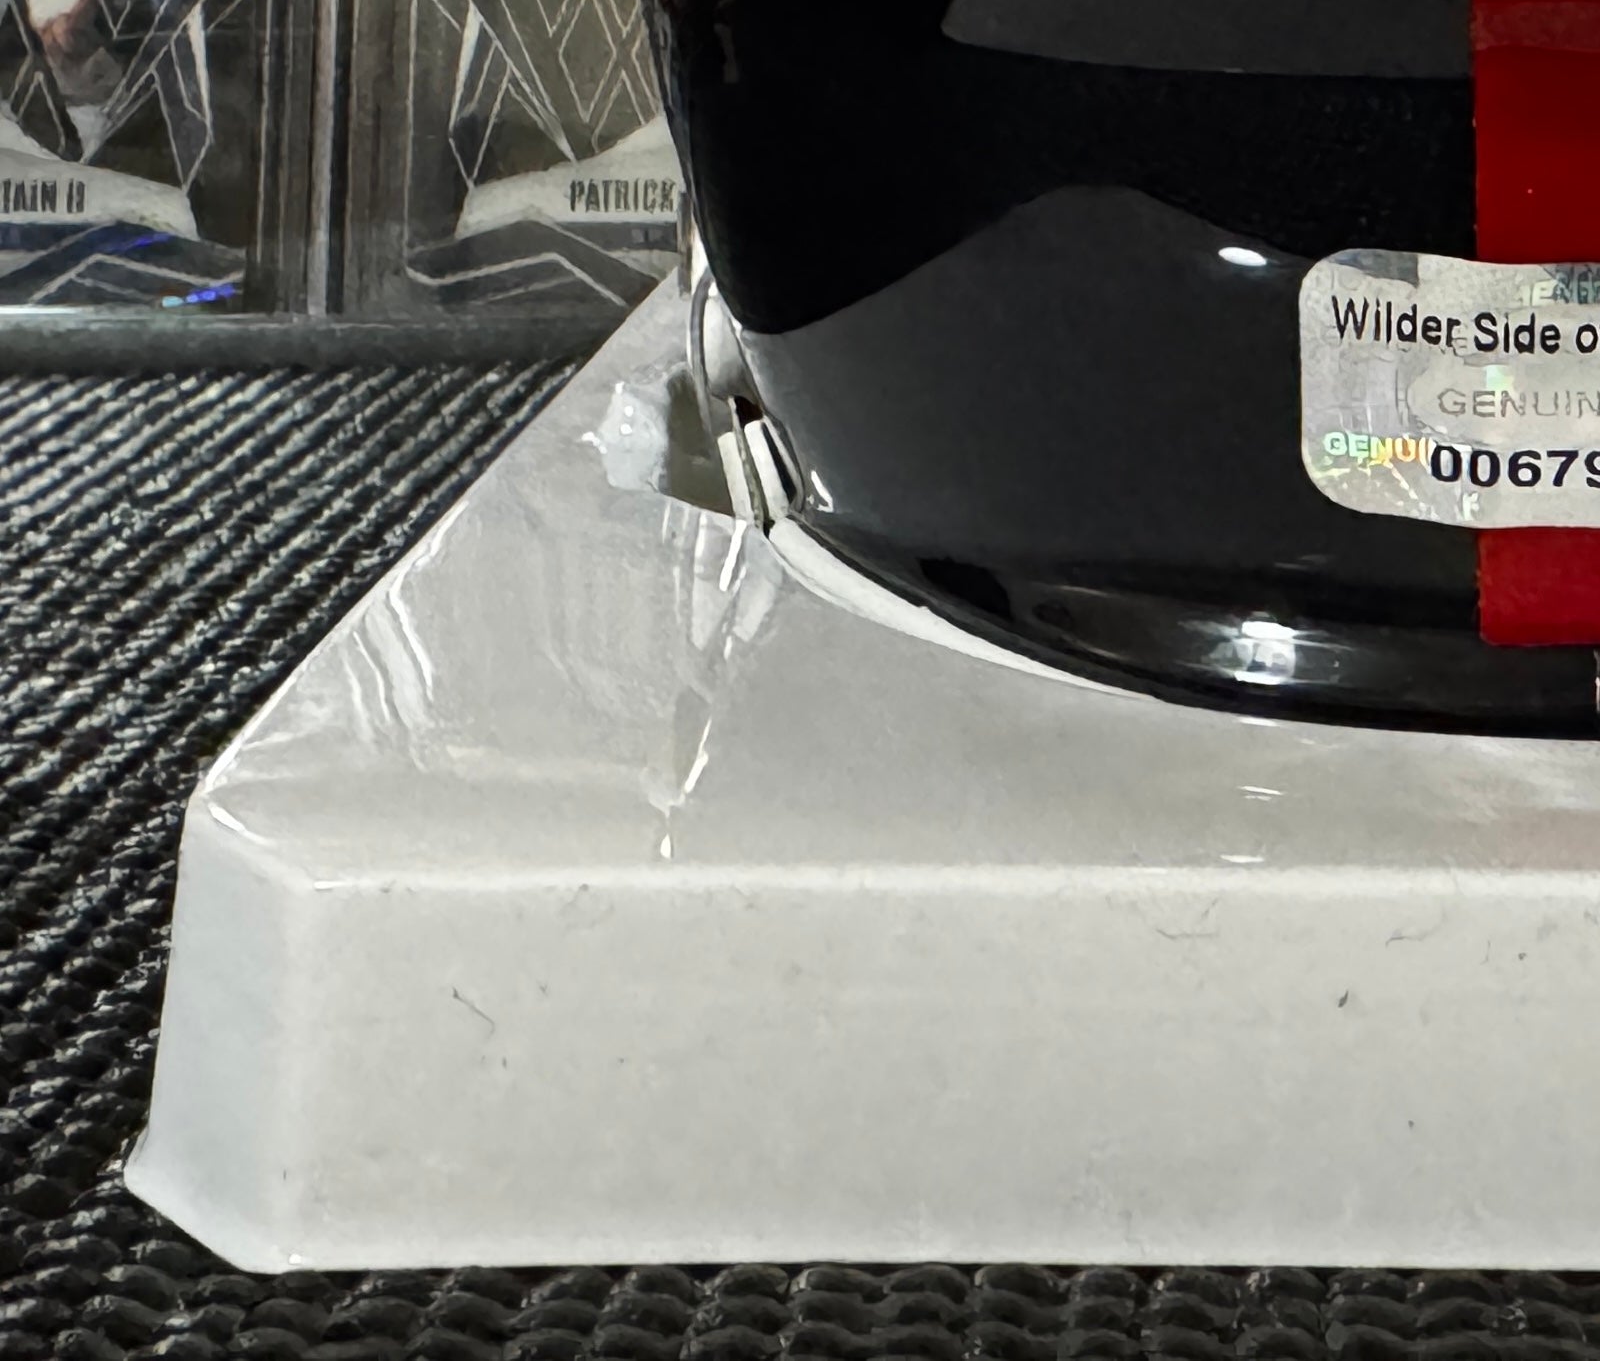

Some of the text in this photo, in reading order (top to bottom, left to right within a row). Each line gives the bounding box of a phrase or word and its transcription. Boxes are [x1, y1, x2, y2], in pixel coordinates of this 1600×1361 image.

[569, 178, 676, 215] PATRICK
[1331, 295, 1460, 348] Wilder
[1474, 311, 1561, 354] Side
